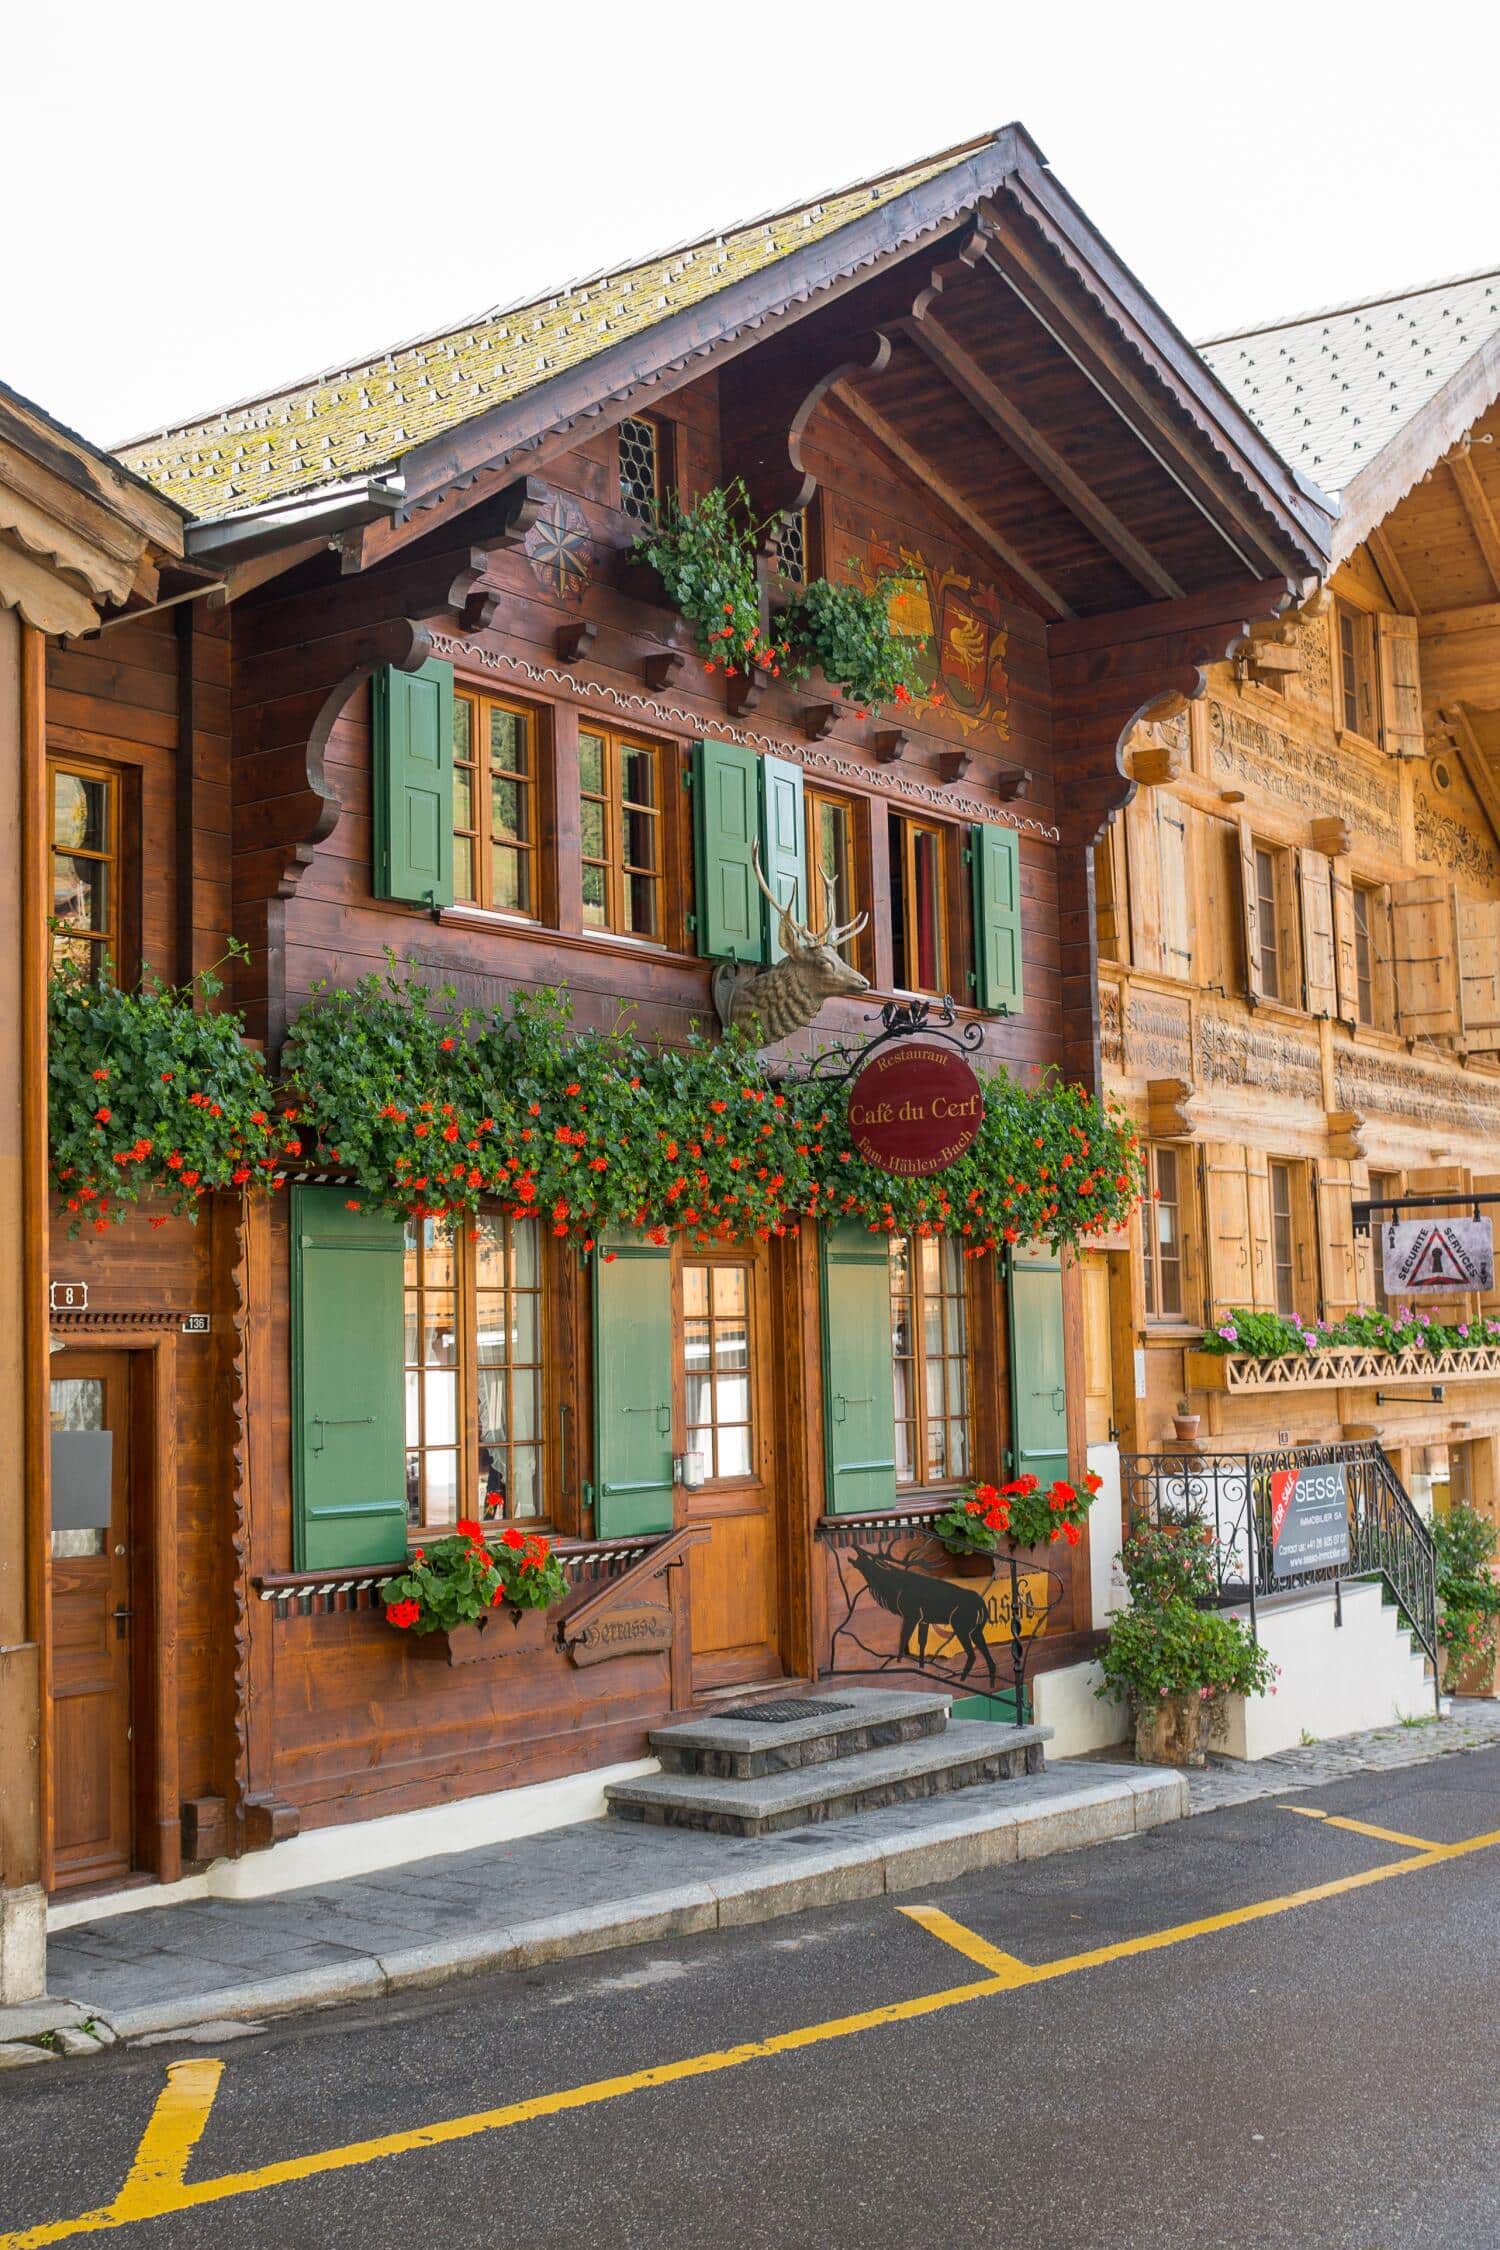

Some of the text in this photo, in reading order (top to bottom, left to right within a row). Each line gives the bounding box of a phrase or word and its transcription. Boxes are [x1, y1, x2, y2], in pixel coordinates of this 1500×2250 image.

[876, 1050, 948, 1072] Restaurant
[850, 1094, 979, 1126] Café du Cerf
[1443, 1227, 1478, 1278] SERVICES
[65, 1287, 74, 1305] 8
[188, 1318, 205, 1329] 136
[1295, 1464, 1345, 1504] SESSA
[1273, 1503, 1284, 1531] FOR
